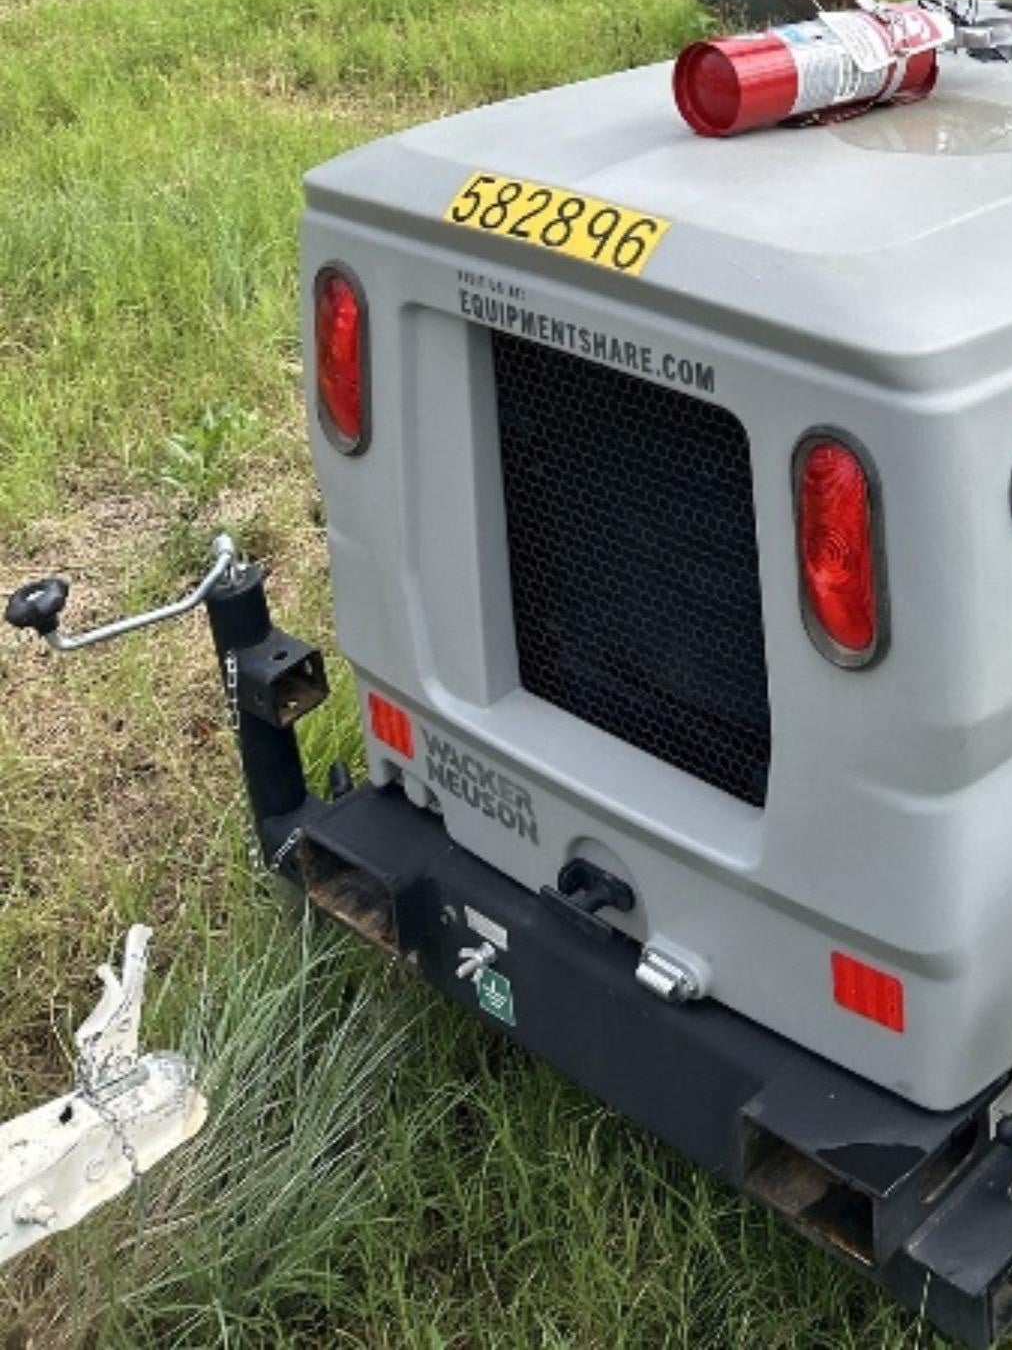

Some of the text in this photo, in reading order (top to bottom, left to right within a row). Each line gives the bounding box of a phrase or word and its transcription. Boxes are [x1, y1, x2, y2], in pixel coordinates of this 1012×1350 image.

[452, 175, 657, 269] 582896
[458, 289, 716, 394] EQUIPMENTSHARE.COM
[422, 729, 536, 821] WACKER
[425, 754, 540, 846] NEUSON
